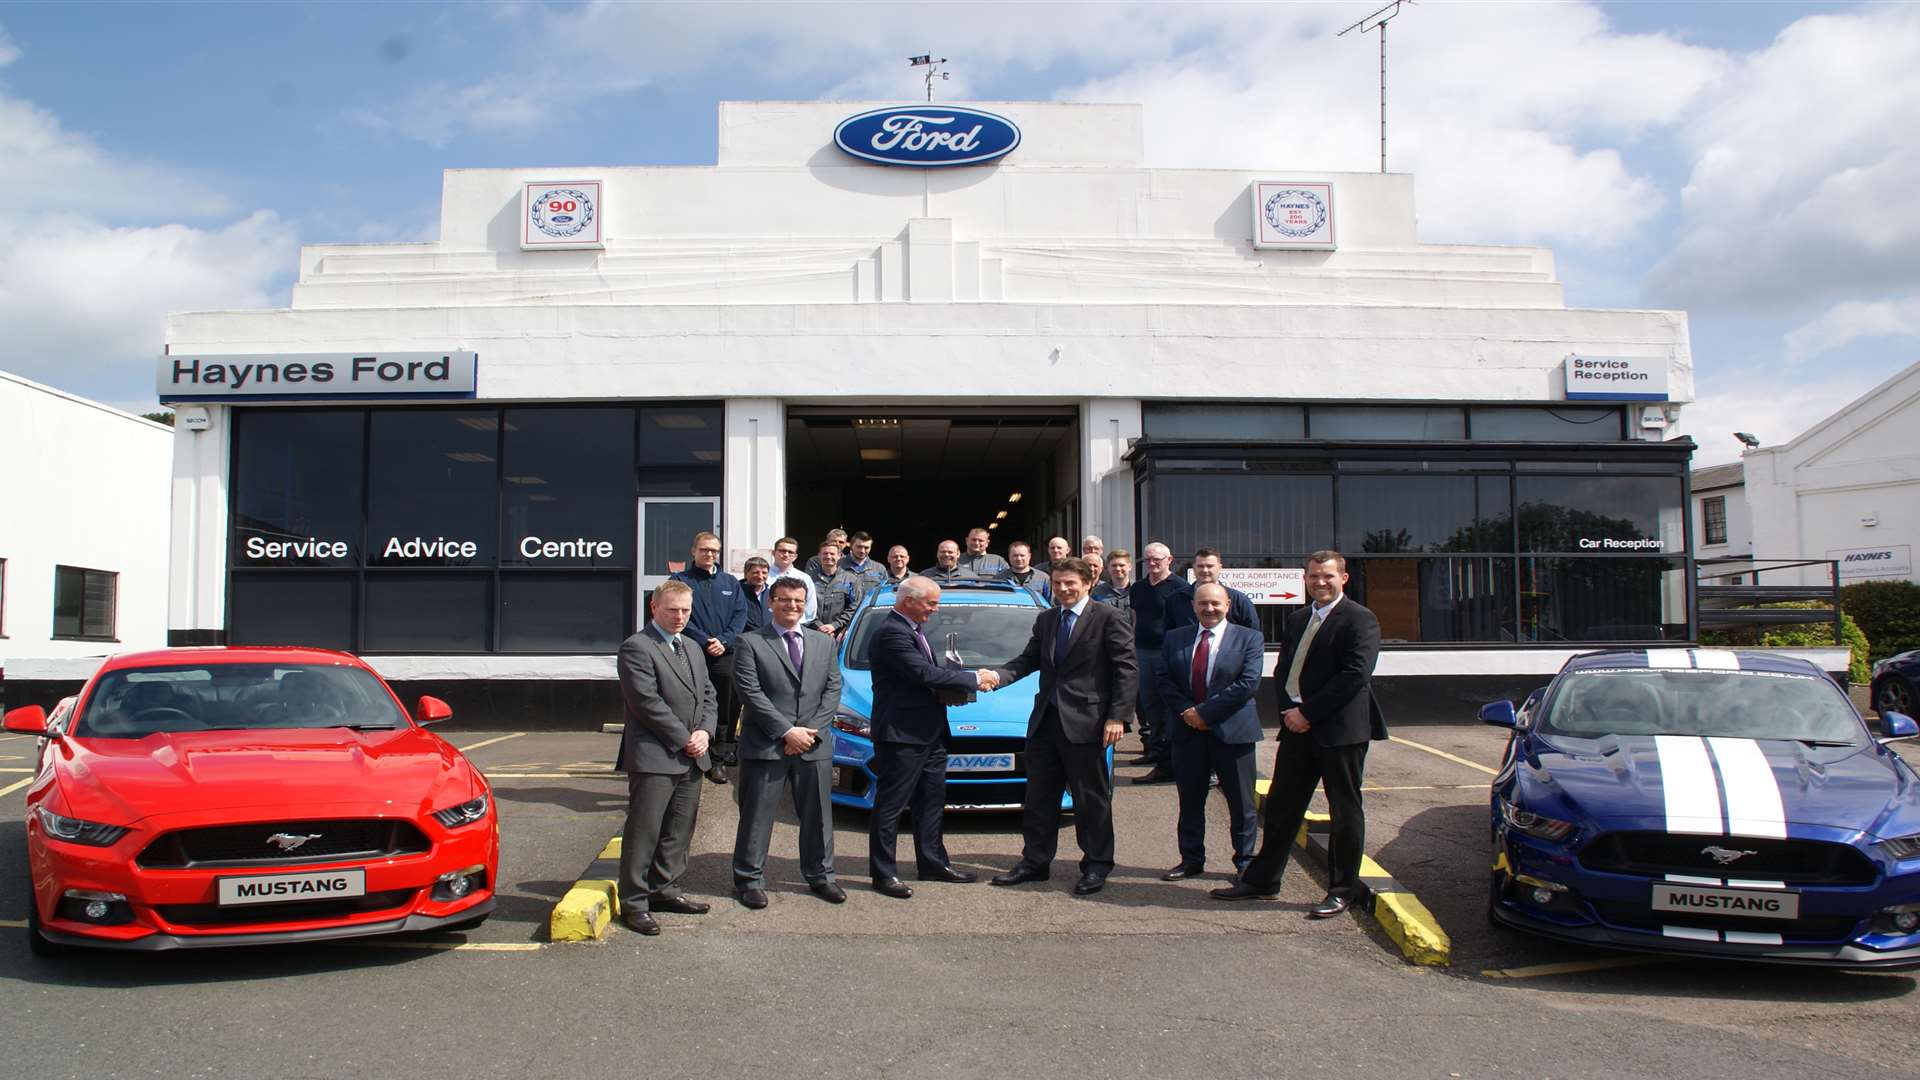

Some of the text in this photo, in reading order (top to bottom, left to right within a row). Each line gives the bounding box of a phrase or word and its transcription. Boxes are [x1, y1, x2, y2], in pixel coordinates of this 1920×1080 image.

[871, 115, 983, 152] Ford
[549, 200, 577, 212] 90
[172, 356, 450, 389] Haynes Ford
[1574, 359, 1629, 369] Service
[1574, 370, 1648, 381] Reception
[246, 537, 348, 558] Service
[383, 537, 477, 558] Advice
[520, 536, 613, 558] Centre
[1579, 538, 1664, 550] Car Reception
[1844, 551, 1893, 562] HAYNES
[237, 878, 347, 897] MUSTANG
[1669, 893, 1780, 912] MUSTANG
